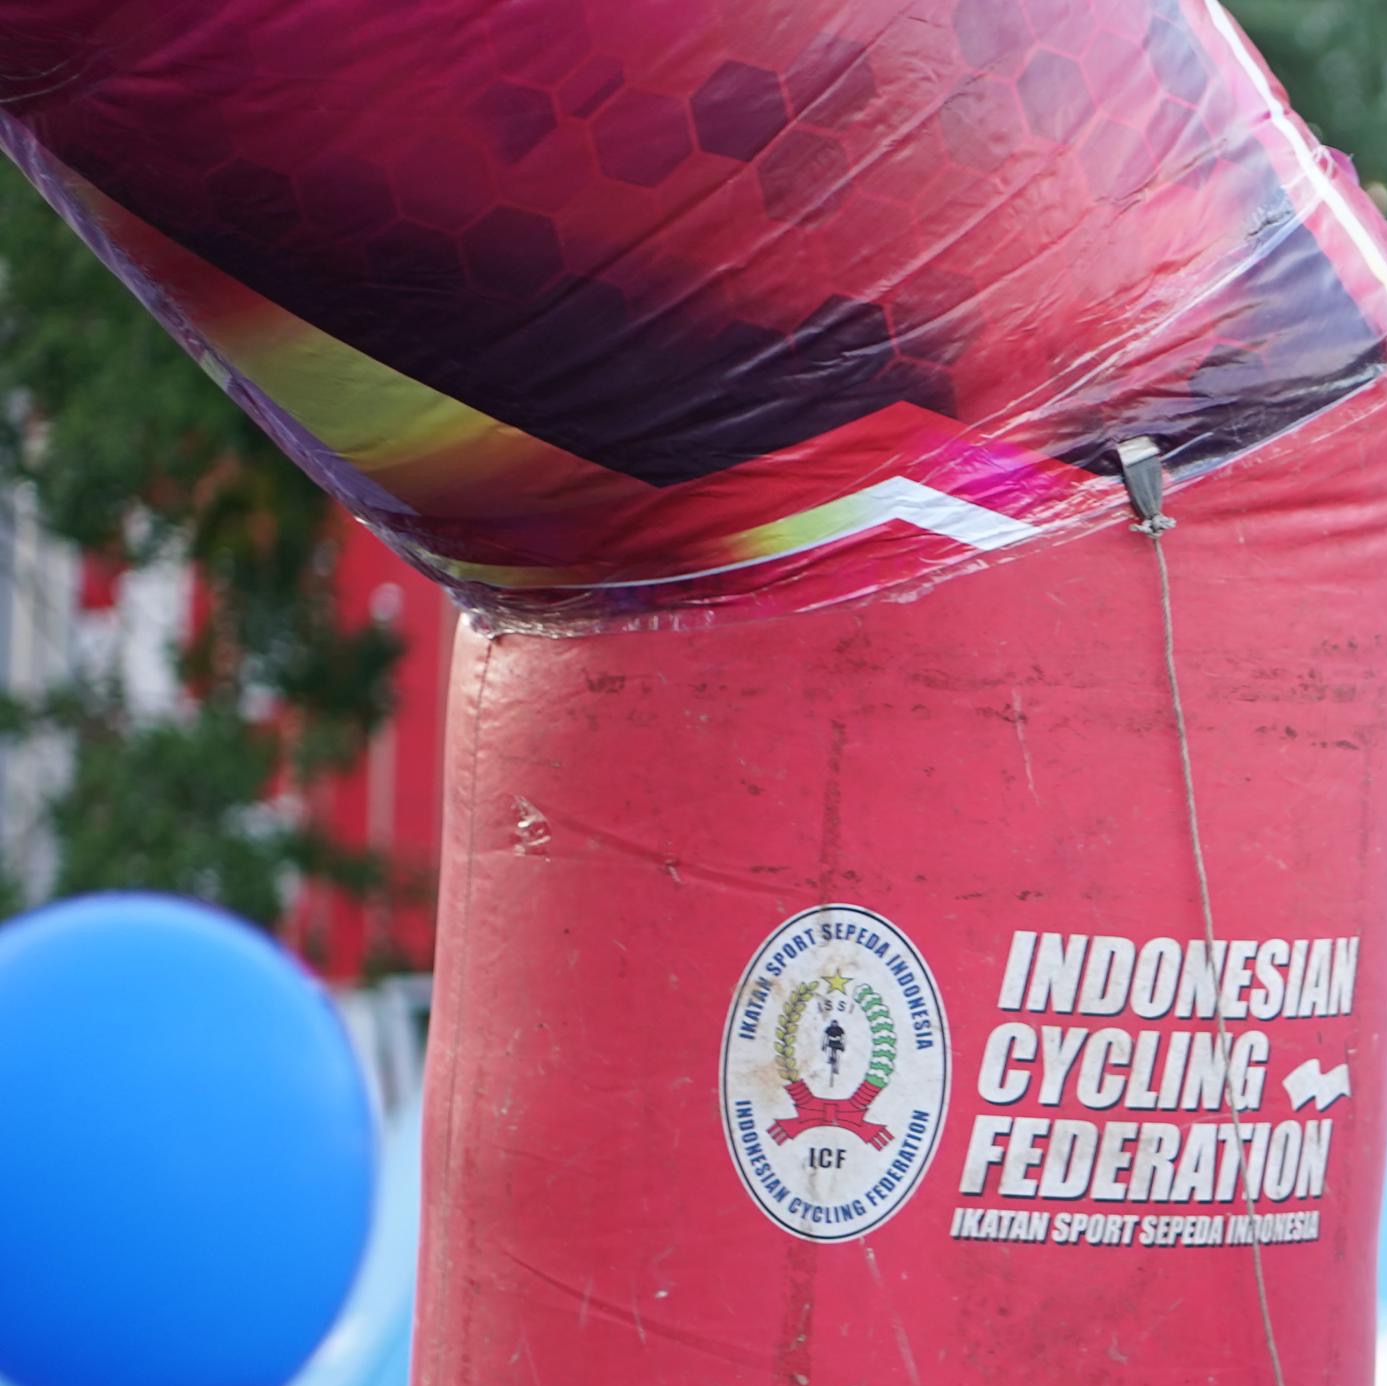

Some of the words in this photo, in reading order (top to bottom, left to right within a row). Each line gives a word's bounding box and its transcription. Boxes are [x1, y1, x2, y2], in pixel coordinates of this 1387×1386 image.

[738, 976, 773, 1040] IKATAN
[765, 928, 817, 976] SPORT
[821, 922, 891, 959] SEPEDA
[885, 954, 934, 1050] INDONESIA
[996, 930, 1360, 1020] INDONESIAN
[976, 1023, 1270, 1112] CYCLING
[735, 1100, 790, 1204] INDONESIAN
[787, 1197, 867, 1224] CYCLING
[864, 1109, 931, 1206] FEDERATION
[808, 1147, 847, 1169] ICF
[958, 1114, 1334, 1203] FEDERATION
[949, 1207, 1050, 1244] IKATAN
[1051, 1211, 1140, 1247] SPORT
[1138, 1214, 1224, 1247] SEPEDA
[1225, 1211, 1321, 1247] INDONESIA
